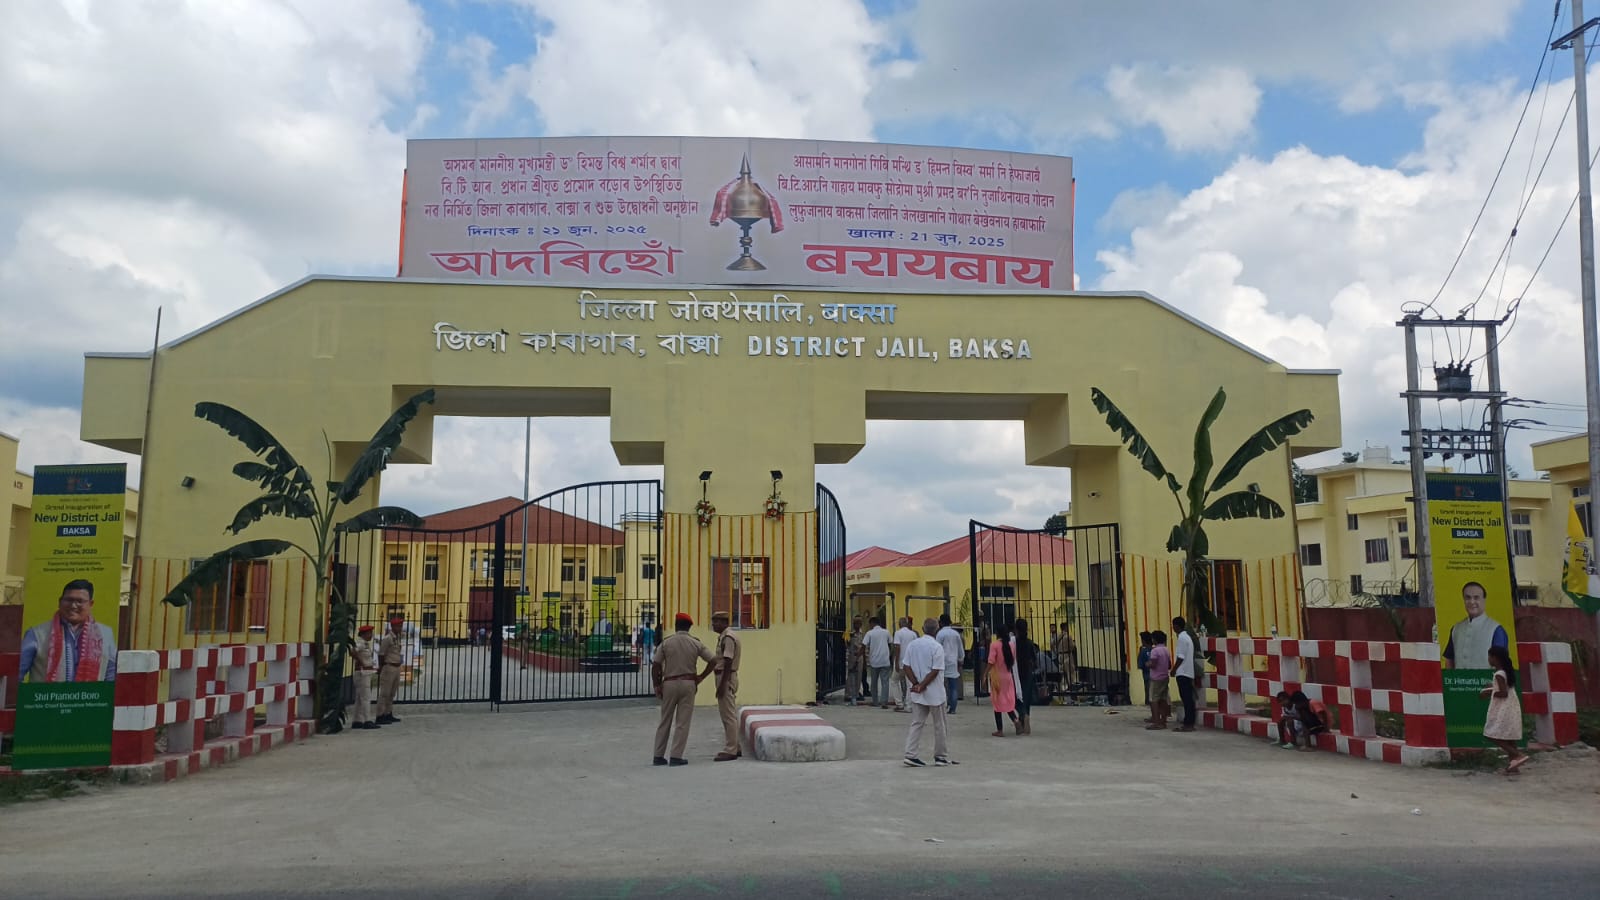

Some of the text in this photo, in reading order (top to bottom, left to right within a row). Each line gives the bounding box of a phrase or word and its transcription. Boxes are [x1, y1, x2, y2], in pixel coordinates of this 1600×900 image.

[910, 231, 927, 242] 21
[969, 236, 1005, 248] 2025
[803, 244, 1053, 289] बरायबाय
[577, 290, 658, 321] जिल्ला
[820, 303, 897, 324] बाक्सा
[748, 335, 1032, 362] DISTRICT JAIL, BAKSA
[34, 512, 121, 523] New District Jail
[1432, 517, 1501, 527] New District Jail
[62, 527, 91, 535] BAKSA
[34, 691, 100, 701] Shri Pramod Boro
